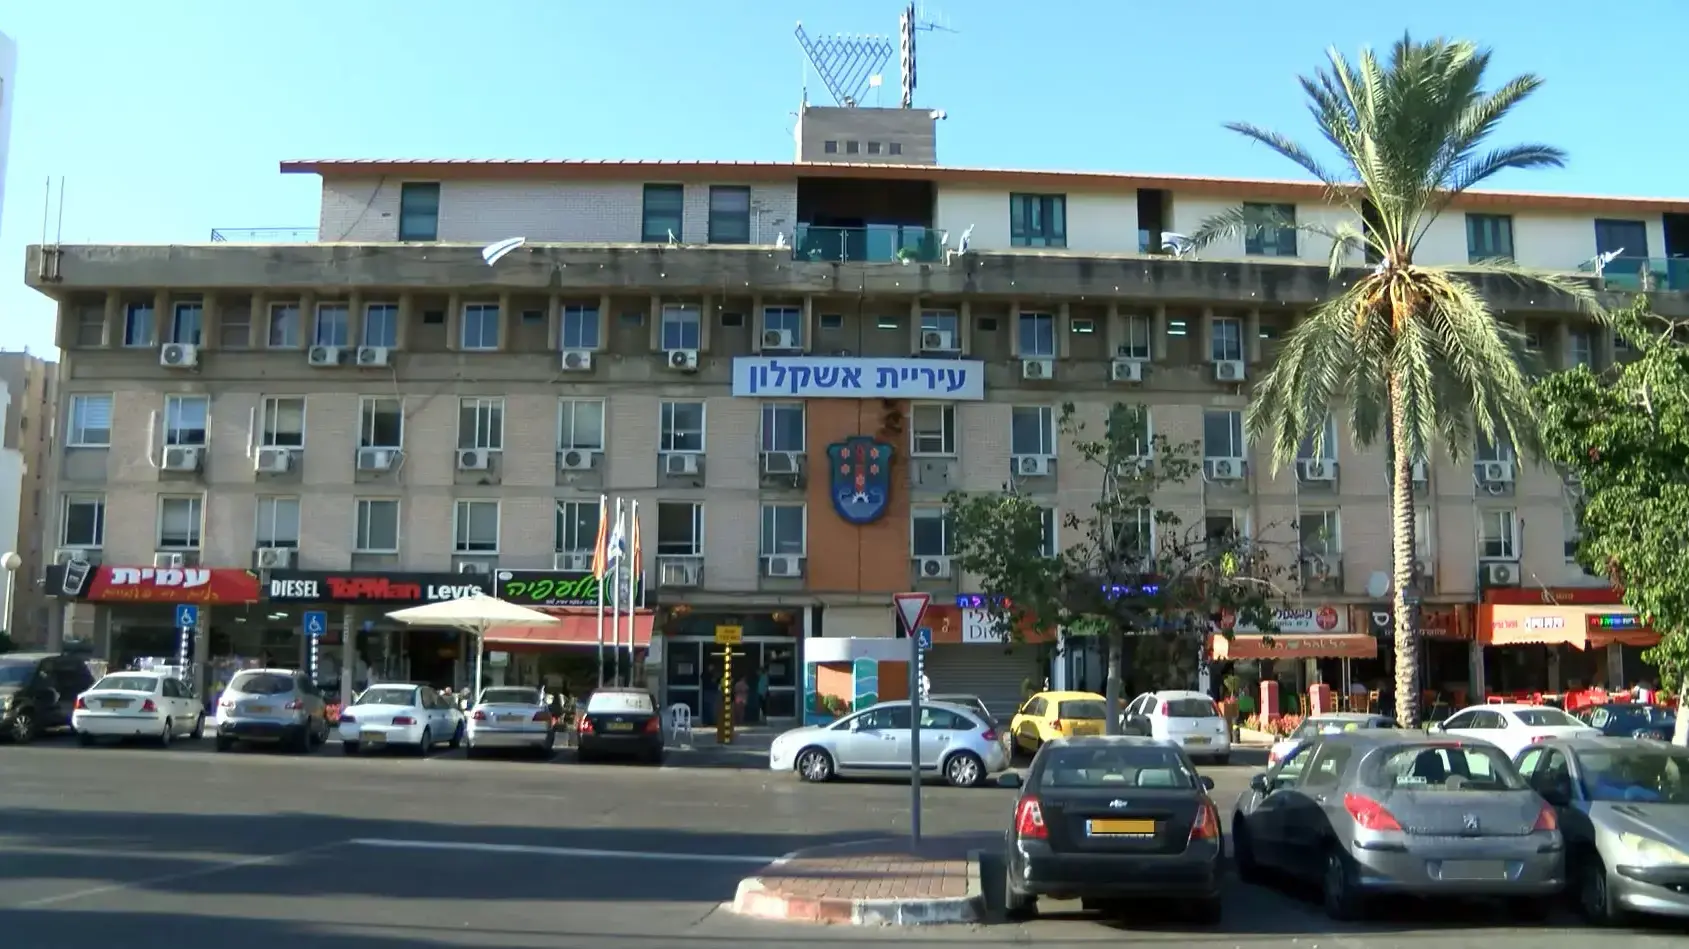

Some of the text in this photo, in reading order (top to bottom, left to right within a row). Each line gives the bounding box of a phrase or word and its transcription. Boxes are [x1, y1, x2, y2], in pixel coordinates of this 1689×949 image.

[749, 360, 967, 393] עיריית אשקלון
[110, 567, 211, 588] עמית
[271, 580, 320, 597] DIESEL
